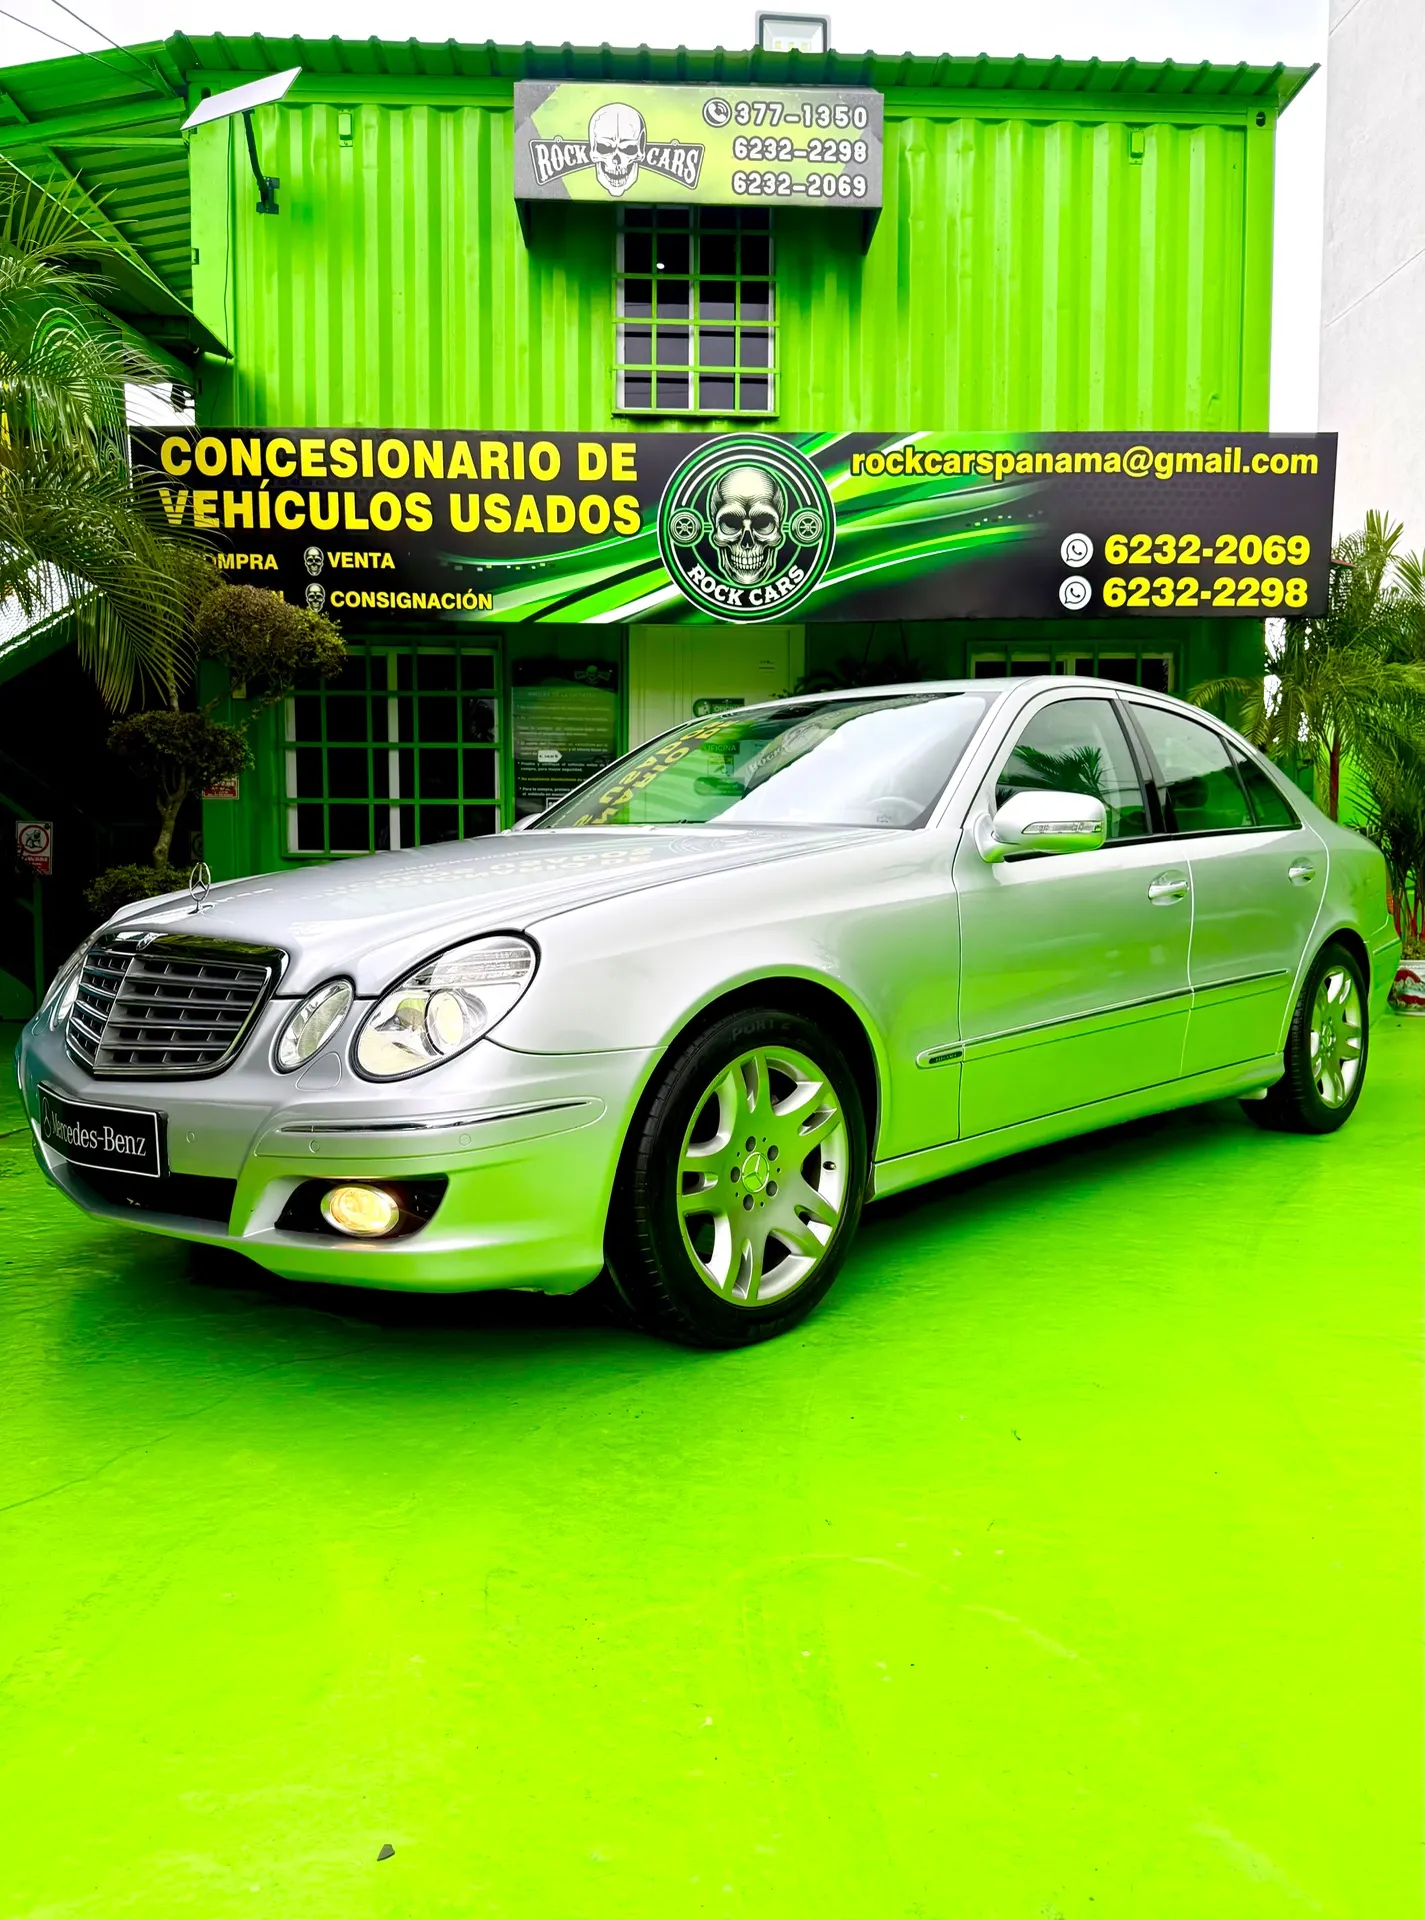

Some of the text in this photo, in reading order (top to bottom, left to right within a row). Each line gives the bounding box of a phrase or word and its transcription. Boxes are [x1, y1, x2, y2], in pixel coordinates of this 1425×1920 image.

[735, 103, 867, 128] 377-1350
[535, 143, 698, 185] ROCK CARS
[733, 137, 867, 163] 6232-2298
[733, 171, 867, 197] 6232-2069
[160, 436, 638, 481] CONCESIONARIO DE
[851, 446, 1319, 480] rockcarspanama@gmail.com
[159, 479, 642, 535] VEHÍCULOS USADOS
[327, 551, 395, 569] VENTA
[1104, 533, 1311, 566] 6232-2069
[329, 588, 494, 610] CONSIGNACIÓN
[687, 563, 806, 606] ROCK CARS
[1102, 576, 1308, 608] 6232-2298
[51, 1110, 147, 1157] Mercedes-Benz
